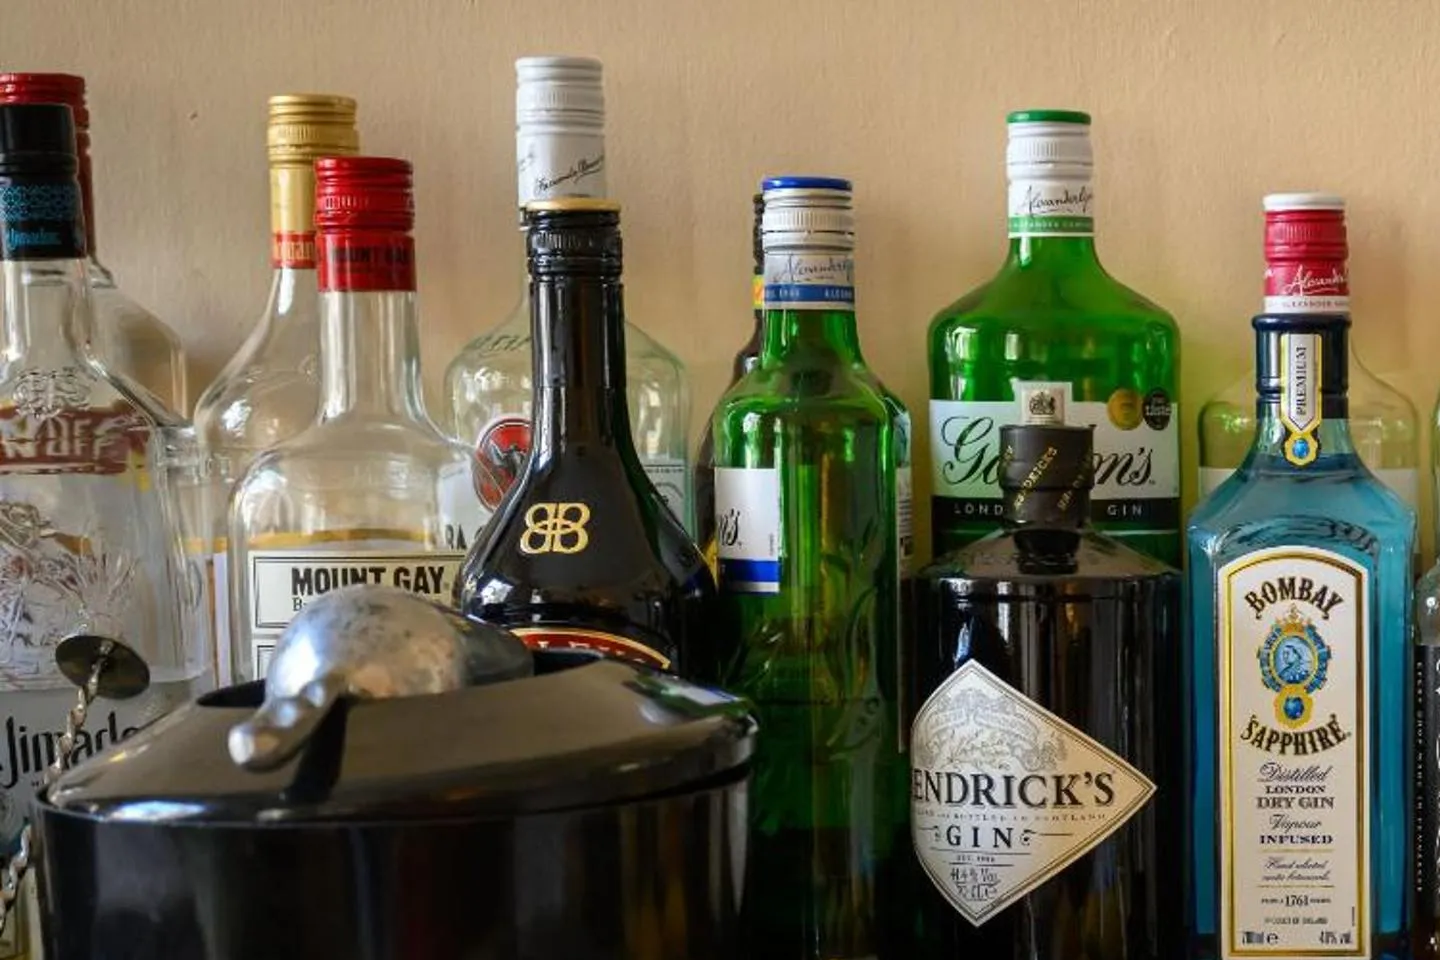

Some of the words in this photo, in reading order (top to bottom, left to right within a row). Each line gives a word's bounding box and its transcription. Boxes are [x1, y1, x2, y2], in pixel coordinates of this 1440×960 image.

[1296, 346, 1307, 416] PREMIUM
[954, 503, 1004, 516] LOND
[1107, 504, 1144, 516] GIN
[291, 567, 386, 596] MOUNT
[393, 566, 445, 595] GAY
[1244, 576, 1344, 620] BOMBAY
[1240, 712, 1347, 756] SAPPHIRE
[1258, 762, 1334, 783] Distilled
[912, 768, 1115, 808] ENDRICK'S
[1265, 785, 1326, 795] LONDON
[1256, 797, 1296, 809] DRY
[1299, 797, 1335, 809] GIN
[946, 825, 1014, 849] GIN
[1259, 835, 1333, 845] INFUSED
